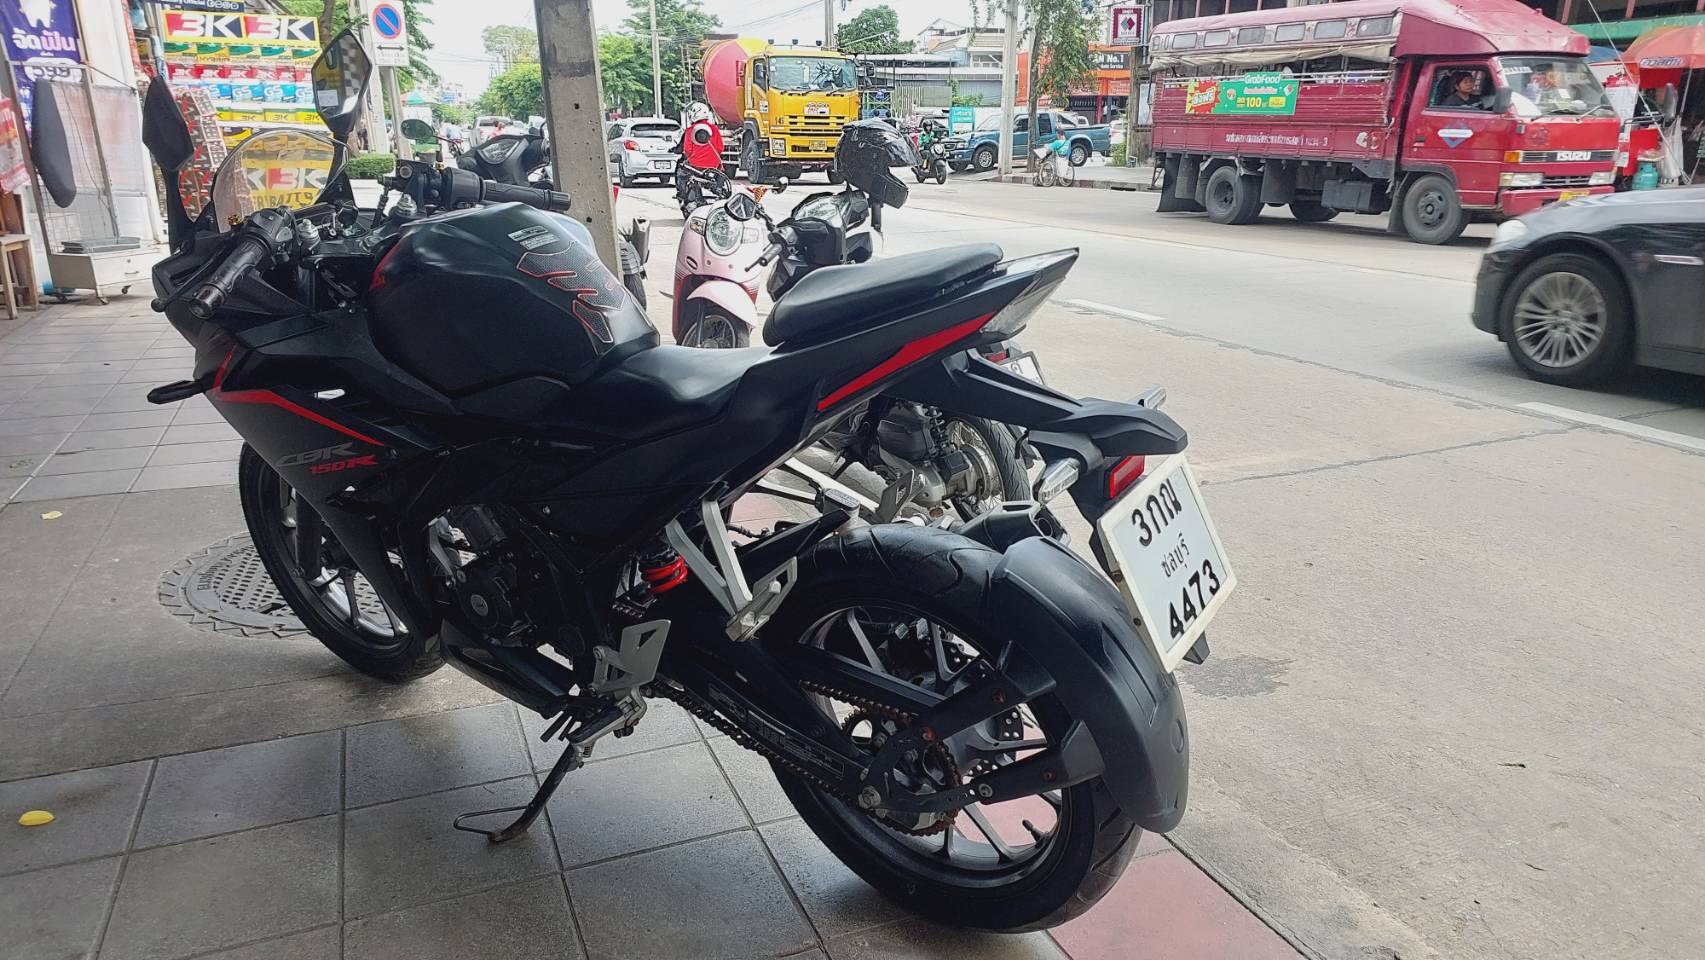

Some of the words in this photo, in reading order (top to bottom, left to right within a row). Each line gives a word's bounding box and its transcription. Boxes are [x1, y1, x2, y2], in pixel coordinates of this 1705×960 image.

[172, 13, 240, 38] 3K
[247, 16, 314, 41] 3K
[12, 27, 77, 51] จัดฟัน
[1244, 74, 1281, 84] GrabFood
[232, 85, 252, 97] GS
[264, 84, 283, 97] GS
[1246, 97, 1262, 107] 100
[1556, 151, 1592, 161] ISUZU
[310, 454, 379, 474] 150R
[1160, 531, 1190, 578] ชลบุรี
[1169, 558, 1221, 640] 4473
